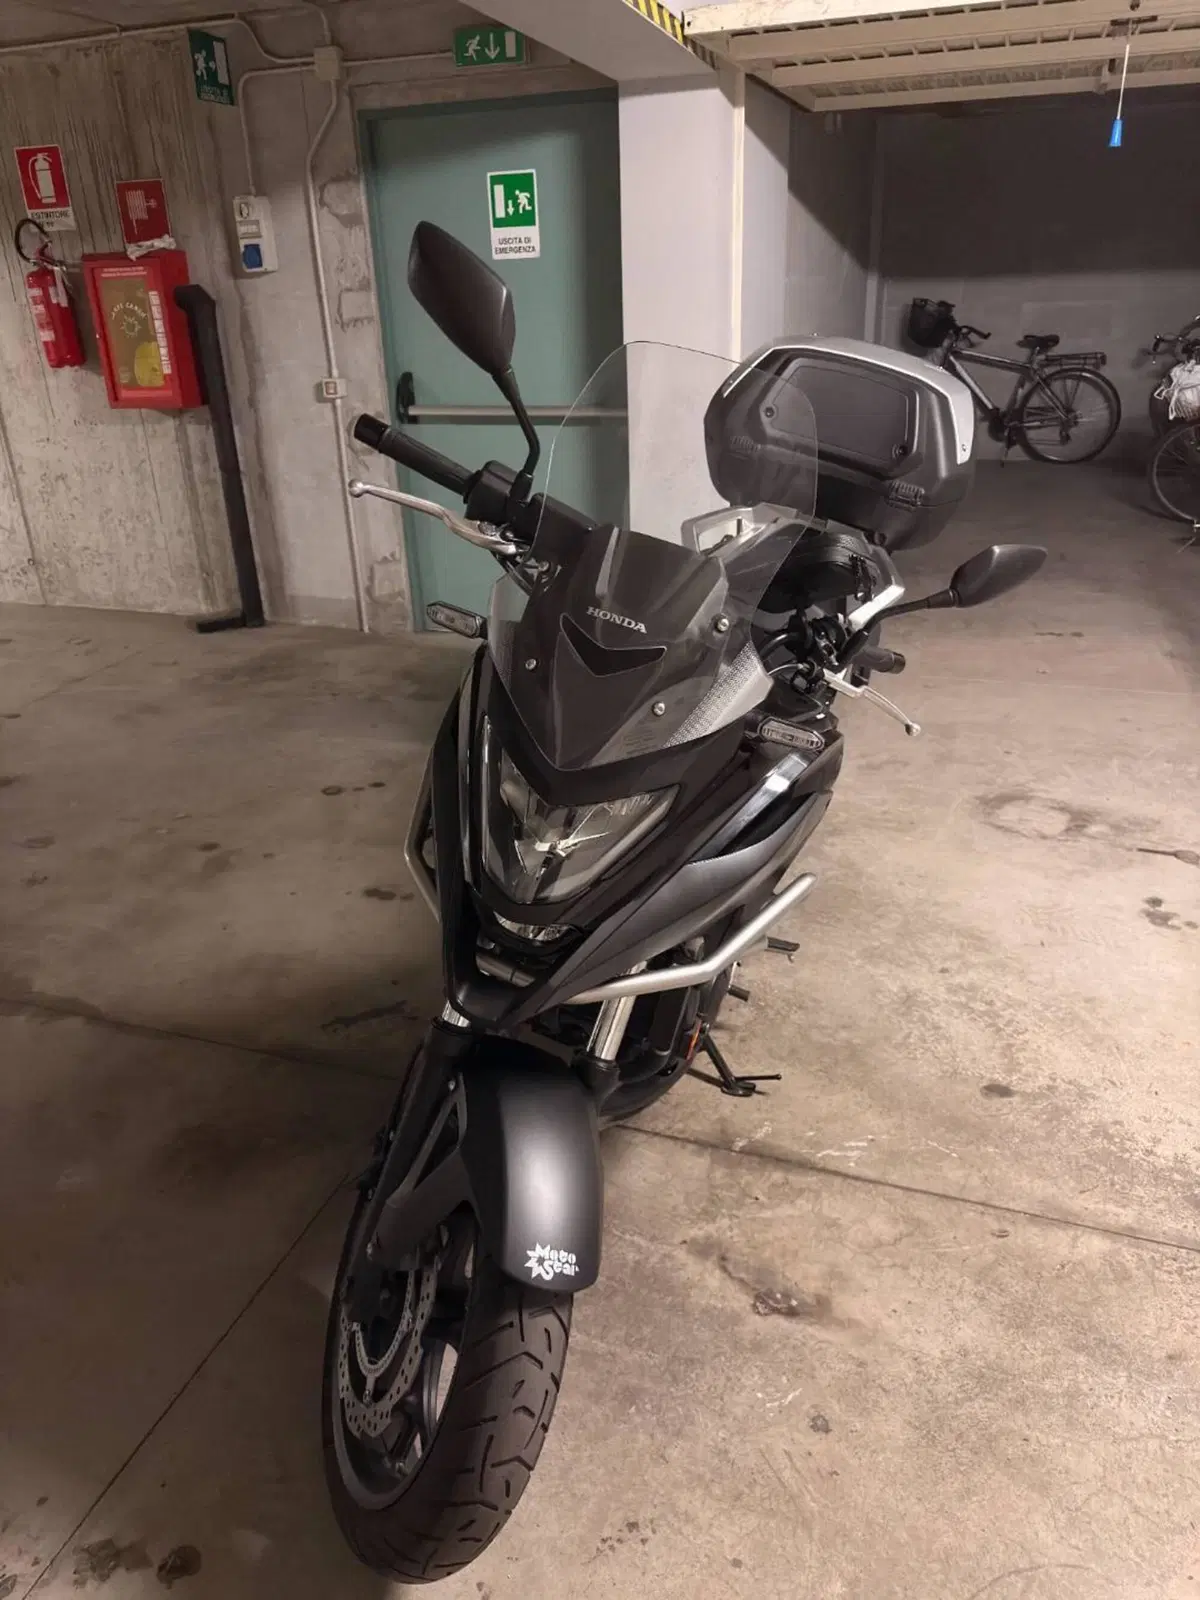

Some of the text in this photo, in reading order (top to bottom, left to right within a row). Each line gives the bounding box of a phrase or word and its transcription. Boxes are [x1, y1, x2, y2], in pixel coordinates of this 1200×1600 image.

[495, 246, 536, 254] EMERGENZA
[498, 236, 522, 245] USCITA
[586, 606, 648, 634] HONDA
[535, 1242, 576, 1264] Moto
[540, 1260, 579, 1280] Star
